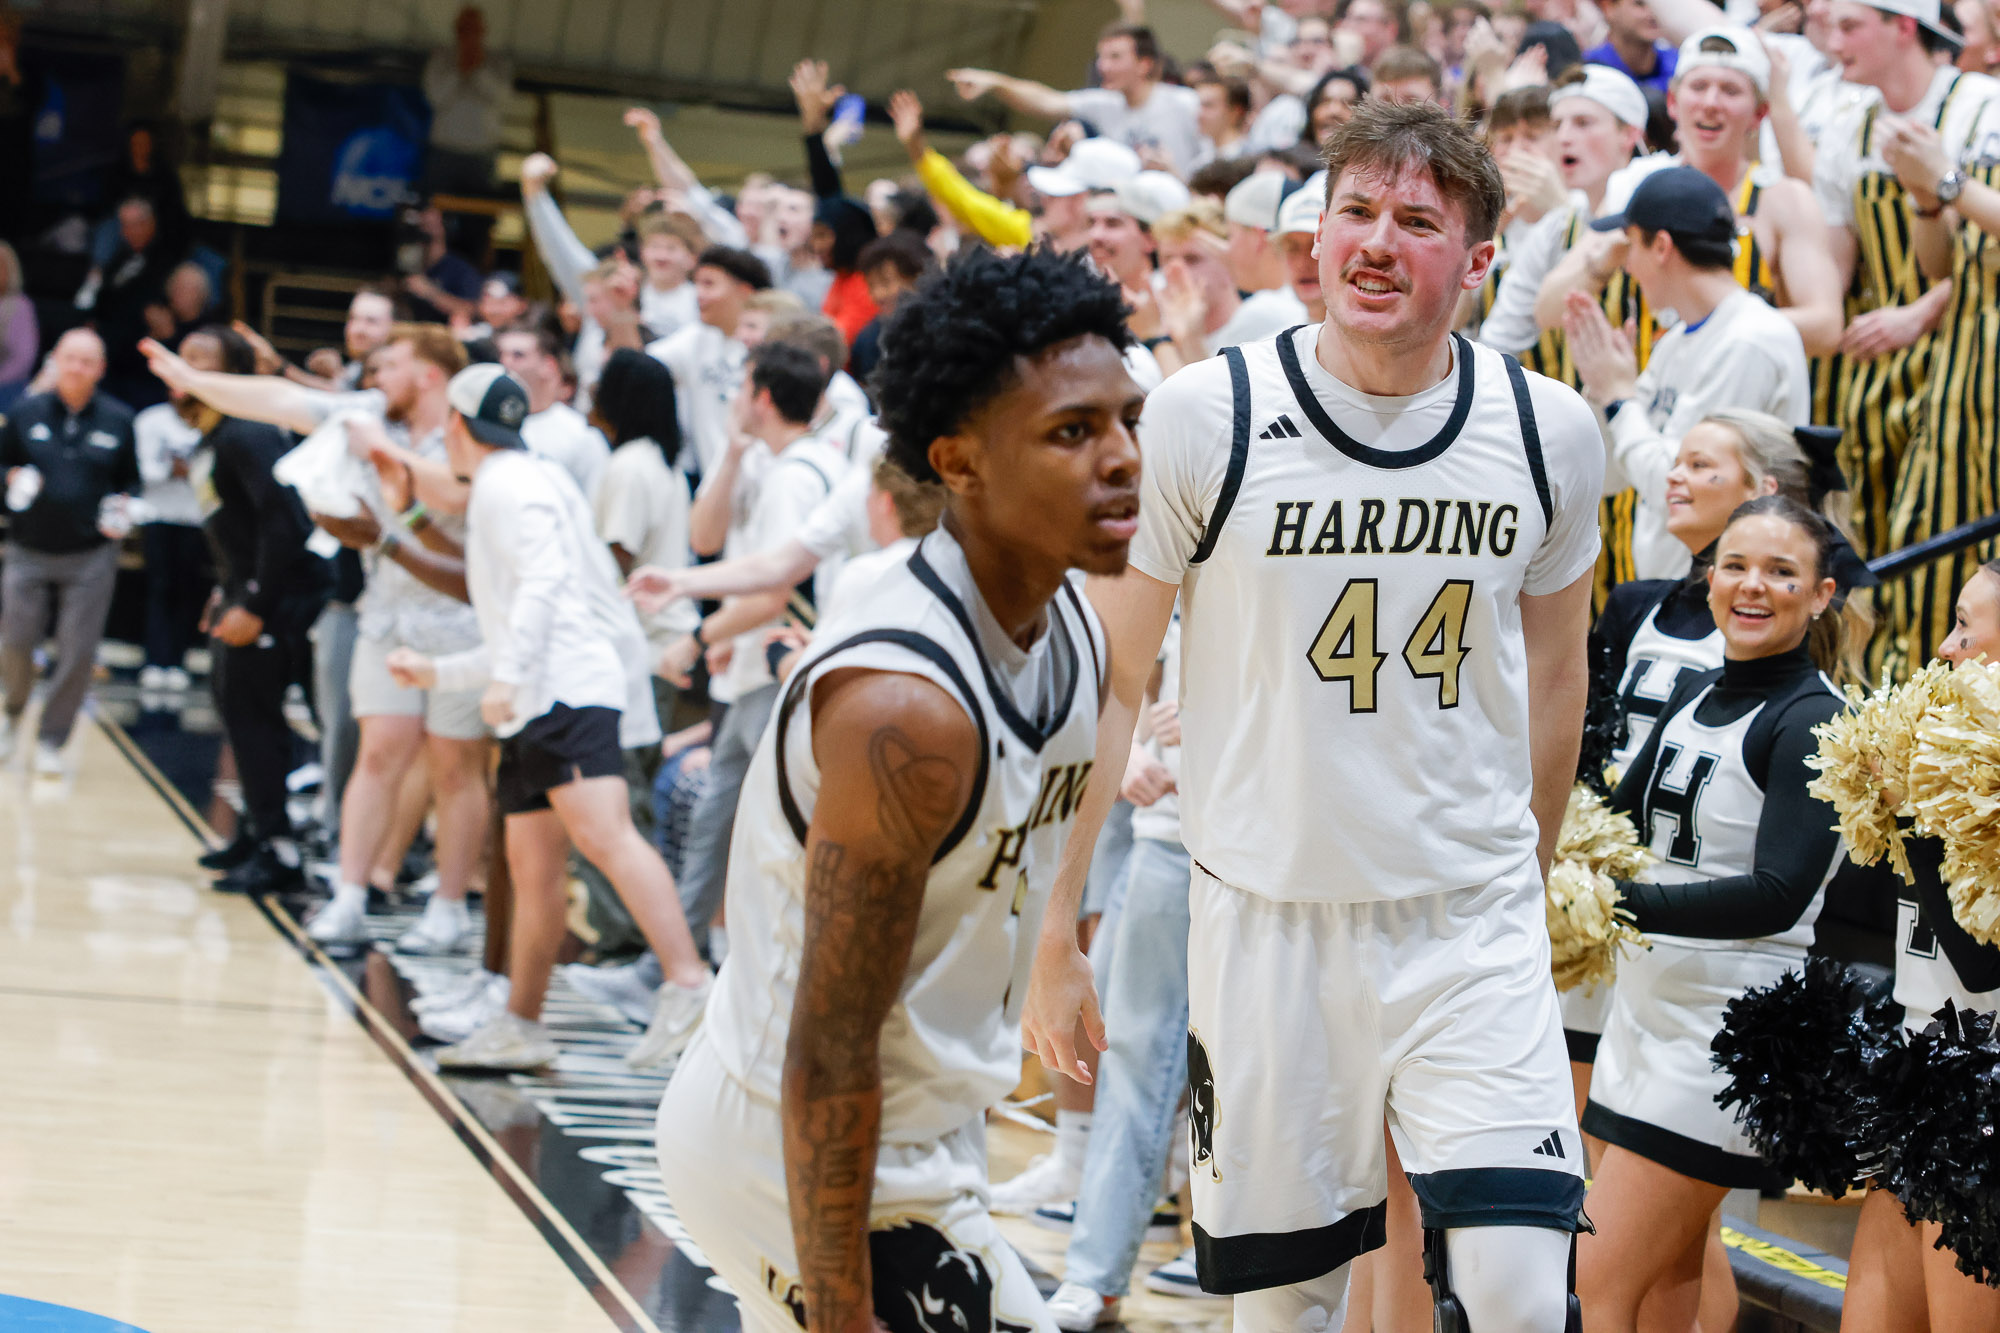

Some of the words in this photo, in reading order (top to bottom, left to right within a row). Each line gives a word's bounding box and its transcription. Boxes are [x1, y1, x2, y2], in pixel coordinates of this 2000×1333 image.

[1265, 497, 1519, 558] HARDING
[1306, 578, 1474, 714] 44
[1643, 740, 1722, 868] H
